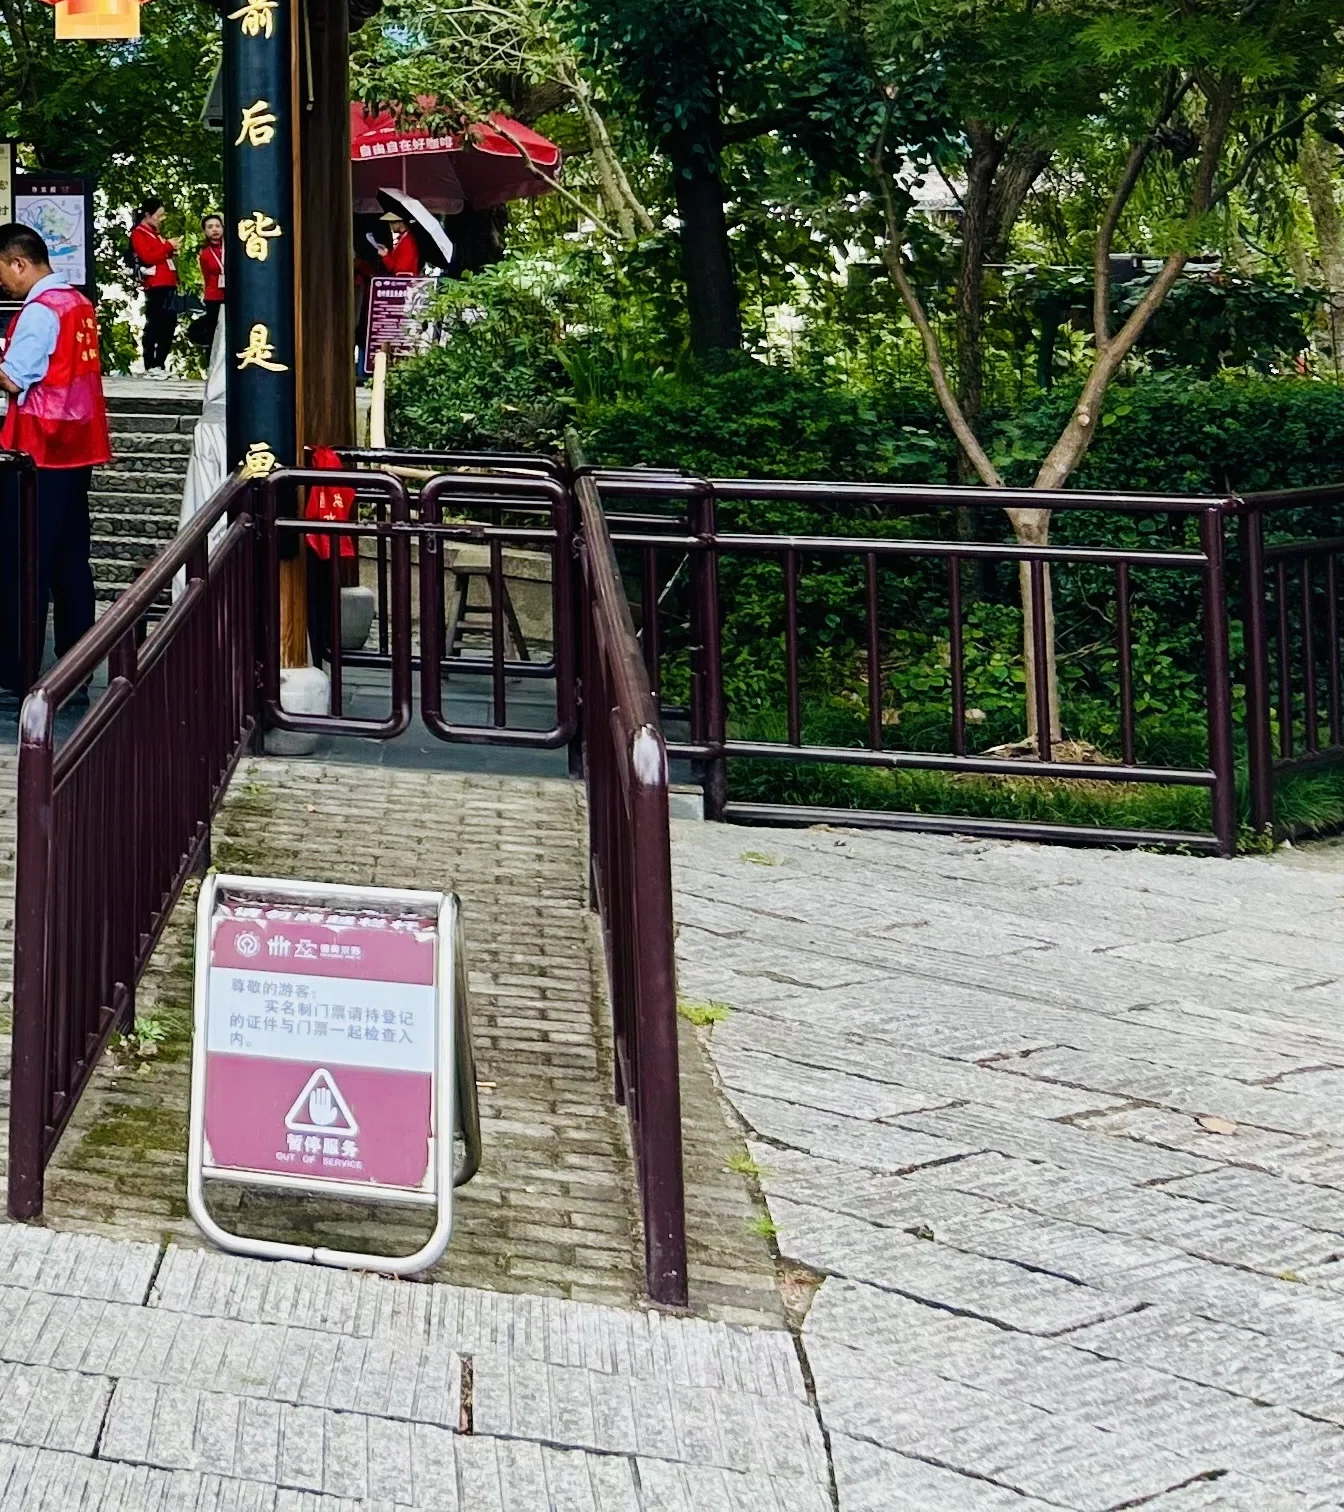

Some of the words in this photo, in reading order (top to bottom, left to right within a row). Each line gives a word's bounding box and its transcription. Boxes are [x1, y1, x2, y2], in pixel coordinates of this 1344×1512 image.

[360, 136, 453, 158] 自由自在好咖啡
[231, 978, 317, 1000] 尊敬的游客：
[265, 999, 415, 1027] 实名制门票请持登记
[229, 1014, 414, 1045] 的证件与门票一起检查入
[286, 1134, 359, 1158] 暂停服务
[275, 1152, 294, 1162] OUT
[302, 1155, 316, 1164] OF
[322, 1157, 363, 1169] SERVICE
